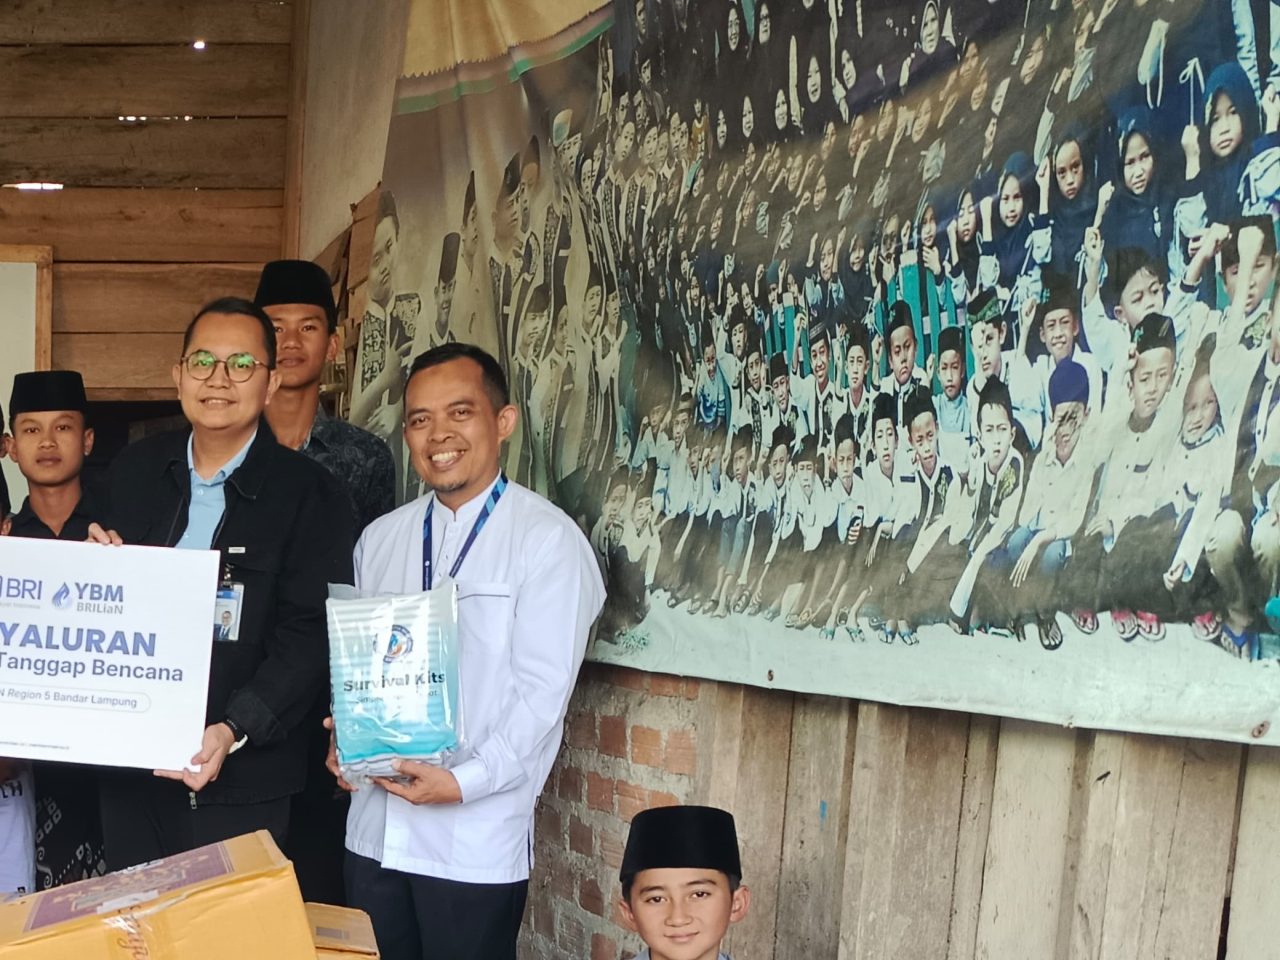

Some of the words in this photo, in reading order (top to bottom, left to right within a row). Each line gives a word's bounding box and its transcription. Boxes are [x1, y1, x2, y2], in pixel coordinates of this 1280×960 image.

[6, 578, 43, 600] BRI
[75, 582, 124, 603] YBM
[76, 602, 124, 615] BRILiaN
[92, 659, 184, 681] Bencana
[415, 671, 446, 685] Kits
[7, 688, 42, 701] Region
[44, 690, 51, 700] 5
[53, 691, 88, 704] Bandar
[91, 692, 138, 708] Lampung
